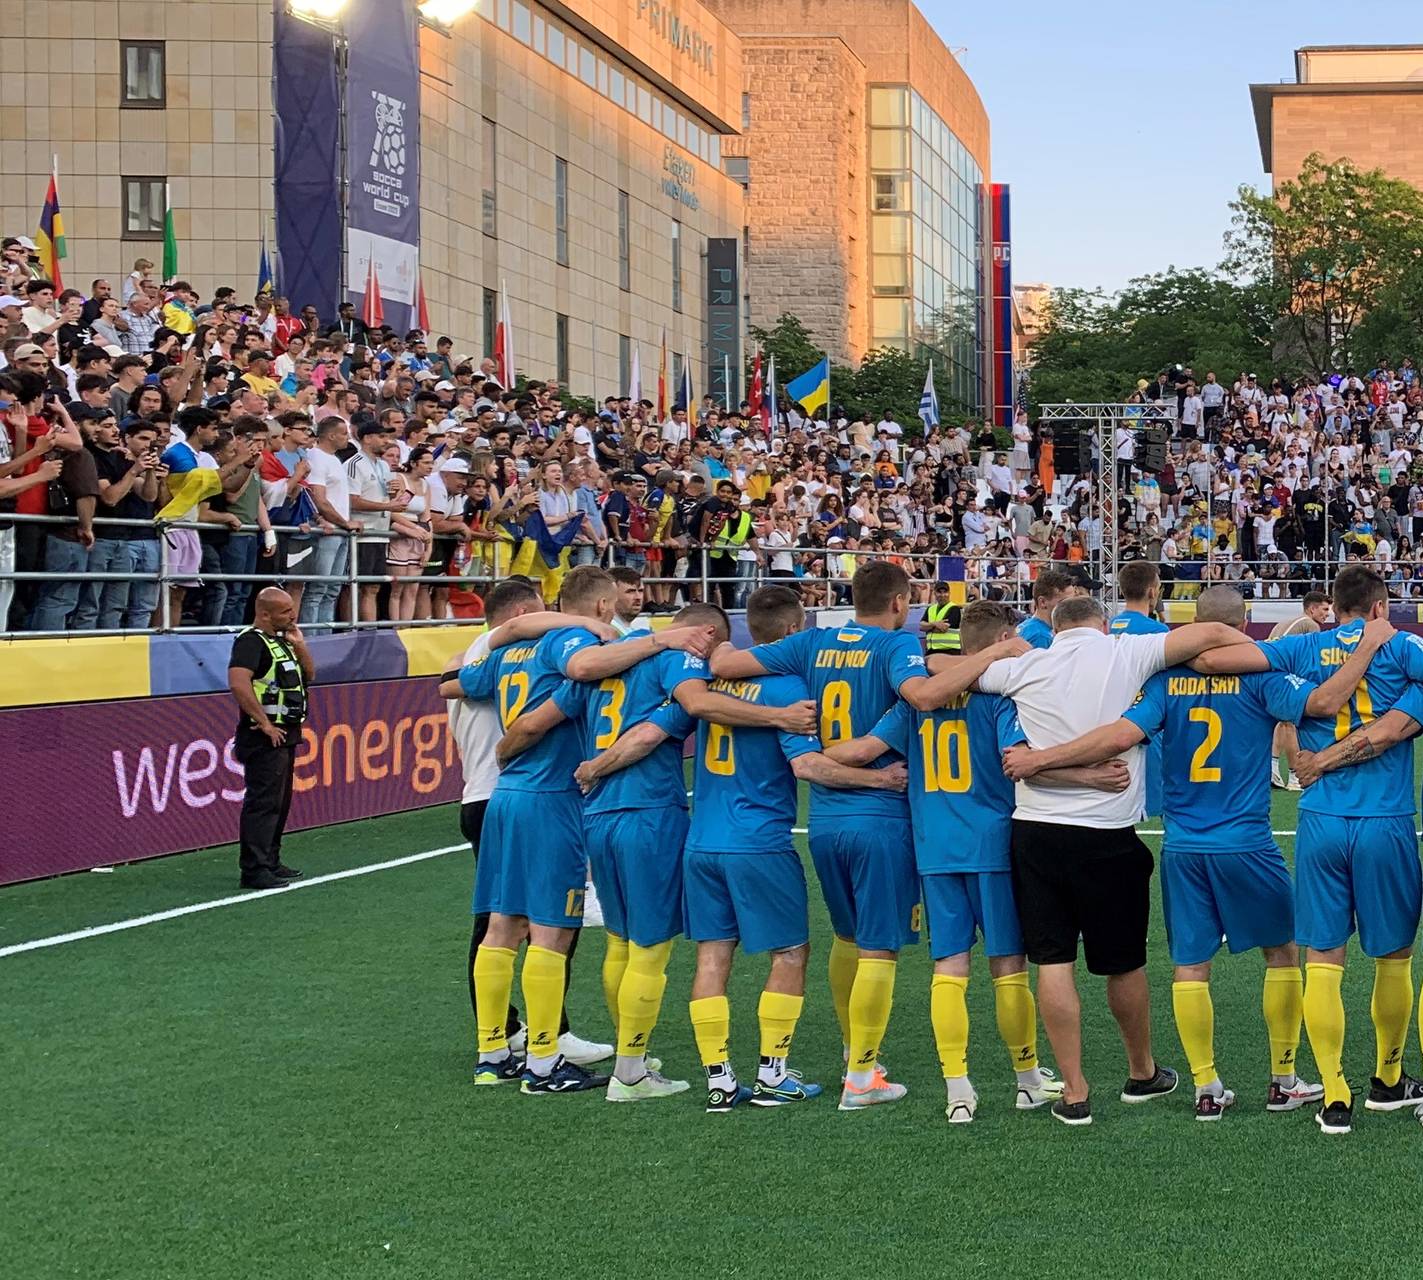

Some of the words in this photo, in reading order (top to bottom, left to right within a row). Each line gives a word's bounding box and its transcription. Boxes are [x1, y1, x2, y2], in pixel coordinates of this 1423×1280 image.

[363, 182, 390, 199] world
[393, 192, 409, 208] cup
[373, 171, 402, 189] socca
[595, 678, 627, 749] 3
[820, 680, 852, 750] 8
[1189, 707, 1222, 783] 2
[918, 718, 972, 793] 10
